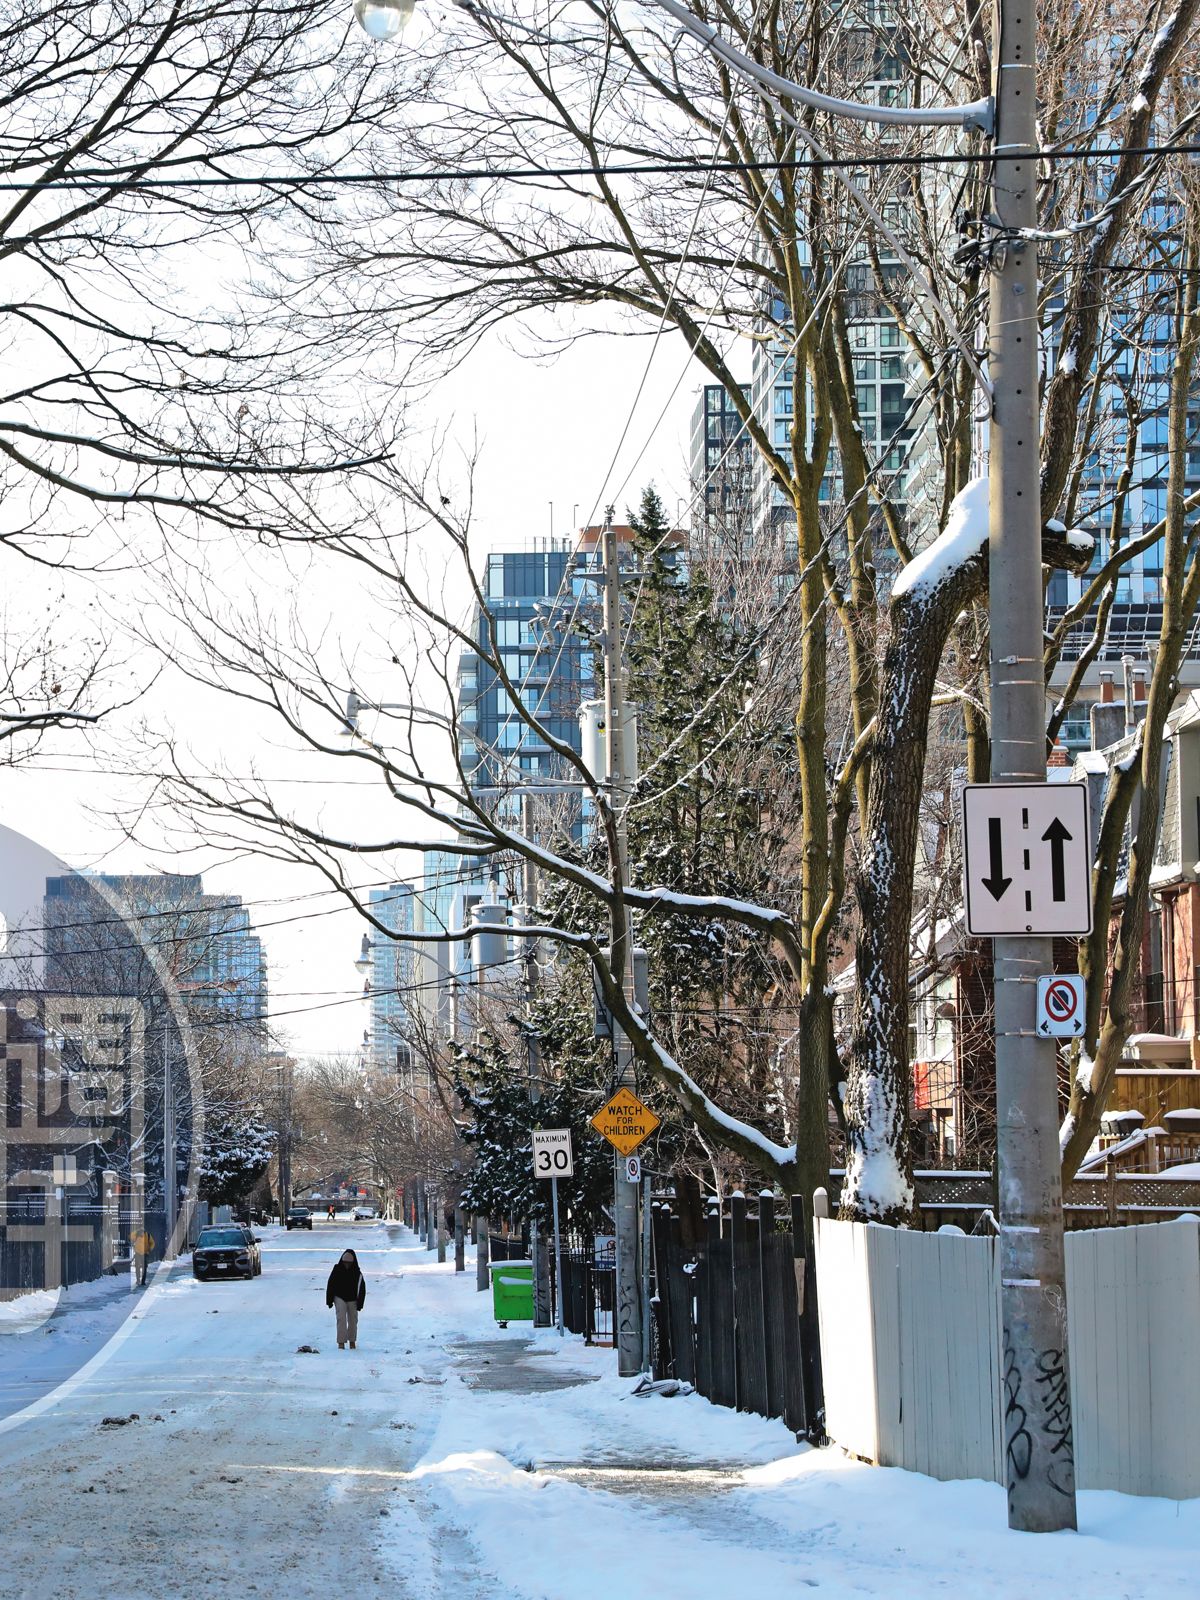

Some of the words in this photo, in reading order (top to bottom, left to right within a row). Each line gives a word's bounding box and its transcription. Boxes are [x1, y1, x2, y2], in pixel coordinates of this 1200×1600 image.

[607, 1105, 643, 1116] WATCH
[616, 1116, 633, 1125] FOR
[603, 1125, 646, 1136] CHILDREN
[535, 1134, 568, 1144] MAXIMUM
[538, 1149, 569, 1171] 30
